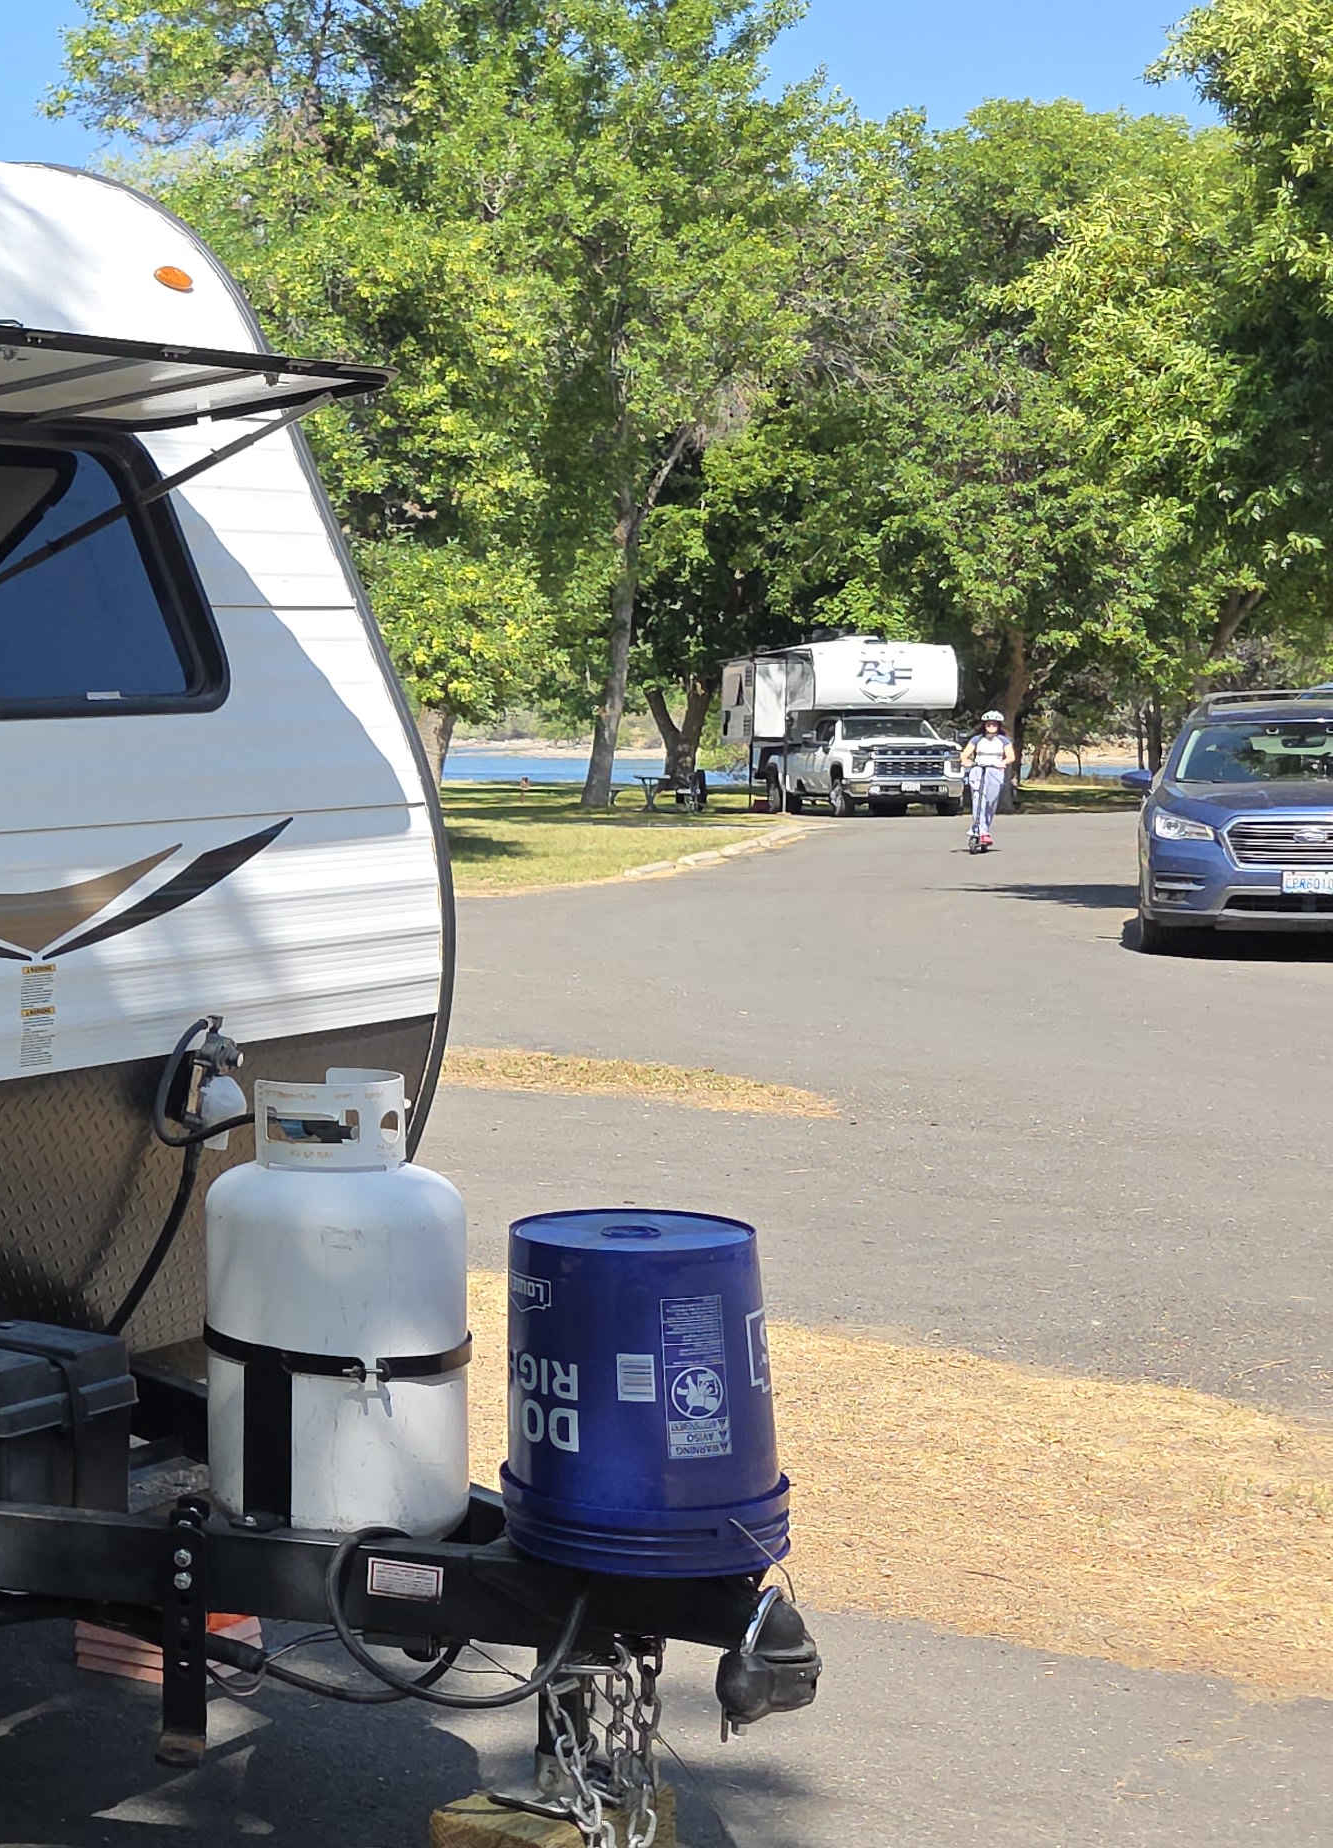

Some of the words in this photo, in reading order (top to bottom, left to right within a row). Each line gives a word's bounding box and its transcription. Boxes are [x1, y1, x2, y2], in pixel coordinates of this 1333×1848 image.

[509, 1348, 579, 1401] RIGH
[521, 1398, 579, 1453] DO
[686, 1433, 714, 1443] AVISO
[676, 1444, 720, 1456] WARNING
